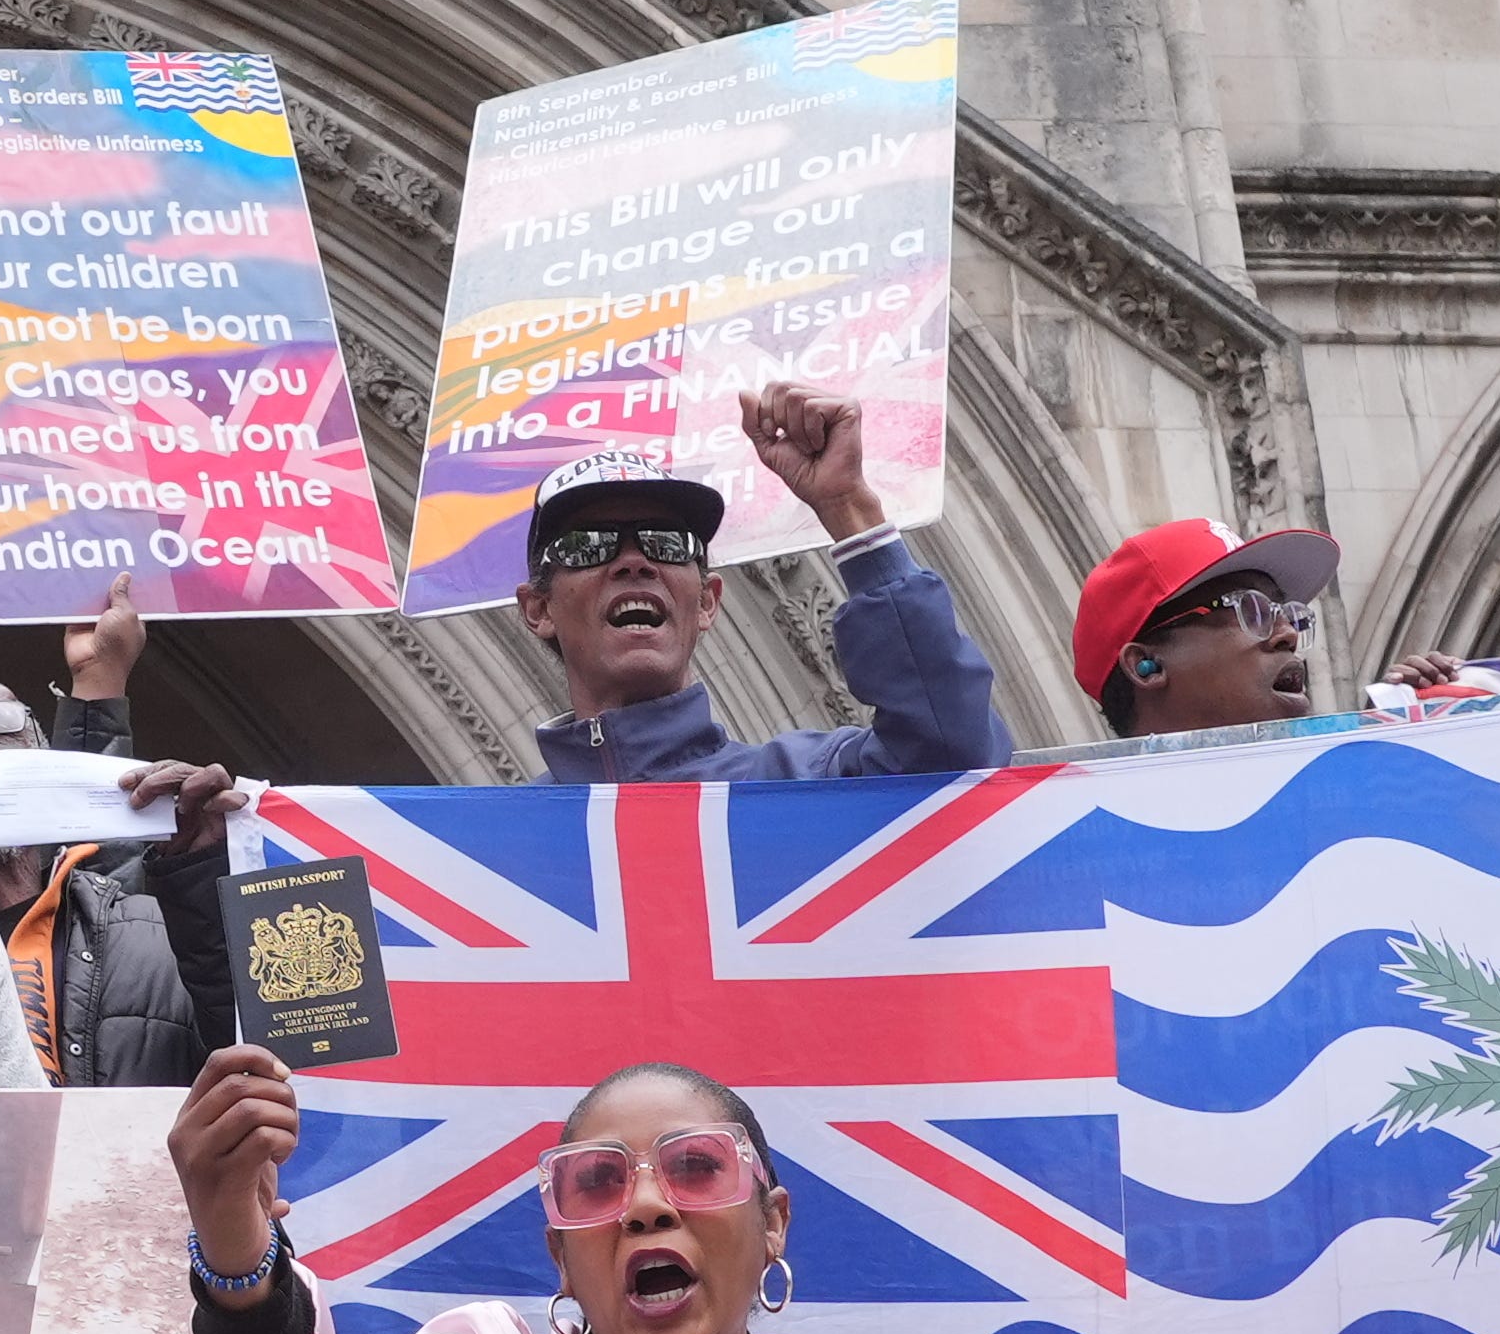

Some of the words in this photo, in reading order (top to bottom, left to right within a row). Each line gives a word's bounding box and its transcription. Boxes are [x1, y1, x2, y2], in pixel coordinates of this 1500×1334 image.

[8, 88, 88, 106] Borders
[93, 89, 123, 107] Bill
[493, 101, 621, 145] Nationality
[626, 94, 642, 114] &
[650, 73, 740, 109] Borders
[745, 60, 779, 86] Bill
[496, 102, 533, 124] 8th
[537, 67, 674, 120] September,
[734, 85, 859, 129] Unfairness
[96, 135, 204, 154] Unfairness
[508, 118, 639, 164] Citizenship
[499, 202, 599, 253] This
[609, 180, 679, 232] Bill
[697, 157, 780, 208] will
[797, 130, 919, 186] only
[81, 206, 154, 237] our
[167, 201, 269, 238] fault
[541, 212, 752, 288] change
[771, 191, 864, 237] our
[46, 253, 239, 290] children
[470, 272, 727, 359] problems
[743, 240, 869, 292] from
[888, 227, 925, 260] a
[105, 305, 169, 343] be
[182, 304, 293, 343] born
[473, 315, 752, 402] legislative
[771, 280, 912, 329] issue
[3, 361, 207, 406] Chagos,
[218, 366, 308, 411] you
[448, 407, 550, 458] into
[566, 396, 602, 431] a
[622, 328, 934, 419] FINANCIAL
[146, 422, 199, 454] us
[208, 413, 319, 453] from
[44, 472, 188, 511] home
[198, 471, 243, 511] in
[254, 468, 334, 508] the
[555, 450, 673, 491] LONDO
[148, 525, 333, 569] Ocean!
[240, 877, 287, 896] BRITISH
[289, 869, 346, 887] PASSPORT
[266, 1028, 285, 1039] AND
[285, 1021, 332, 1036] NORTHERN
[331, 1016, 370, 1030] IRELAND
[272, 1009, 305, 1022] UNITED
[304, 1003, 346, 1017] KINGDOM
[345, 1001, 358, 1010] OF
[284, 1017, 313, 1028] GREAT
[313, 1011, 349, 1024] BRITAIN
